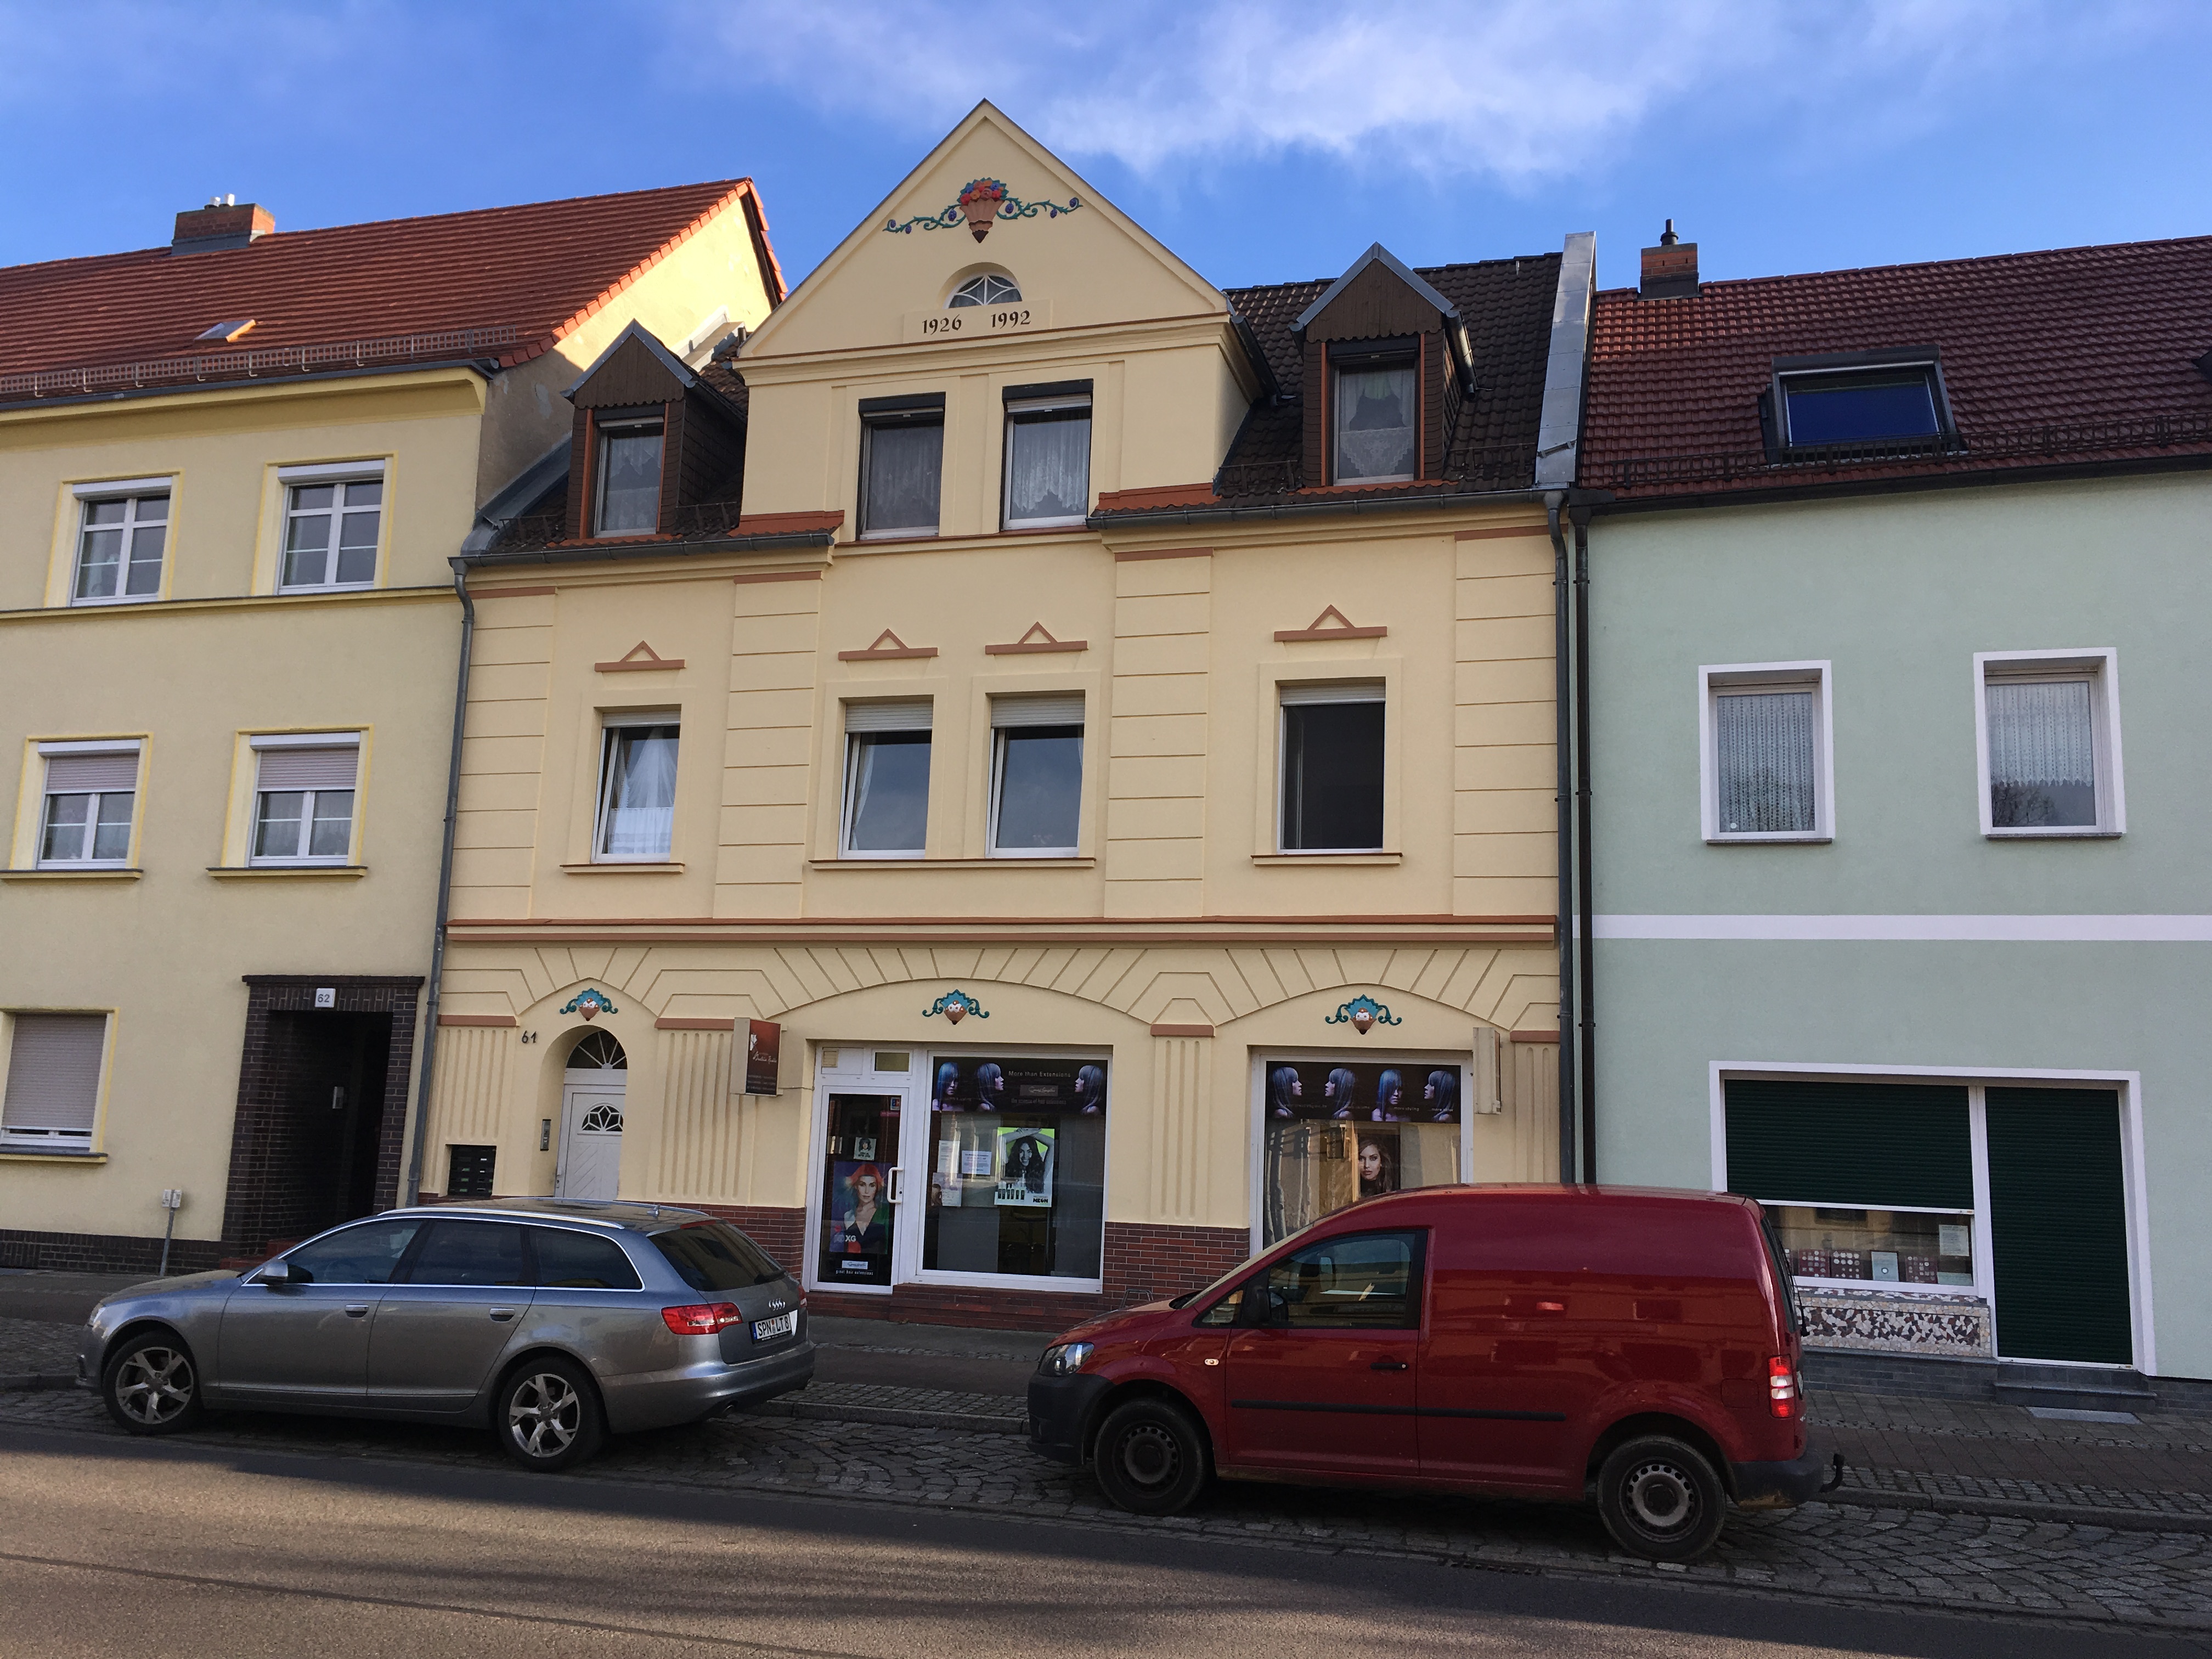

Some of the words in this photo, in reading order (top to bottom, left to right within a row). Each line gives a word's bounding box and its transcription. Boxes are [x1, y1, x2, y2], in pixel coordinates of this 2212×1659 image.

[922, 314, 962, 335] 1926
[990, 310, 1031, 329] 1992
[317, 994, 330, 1003] 62
[521, 1030, 537, 1043] 61
[757, 1321, 771, 1336] SPN
[775, 1318, 783, 1331] LT
[785, 1316, 789, 1329] 8
